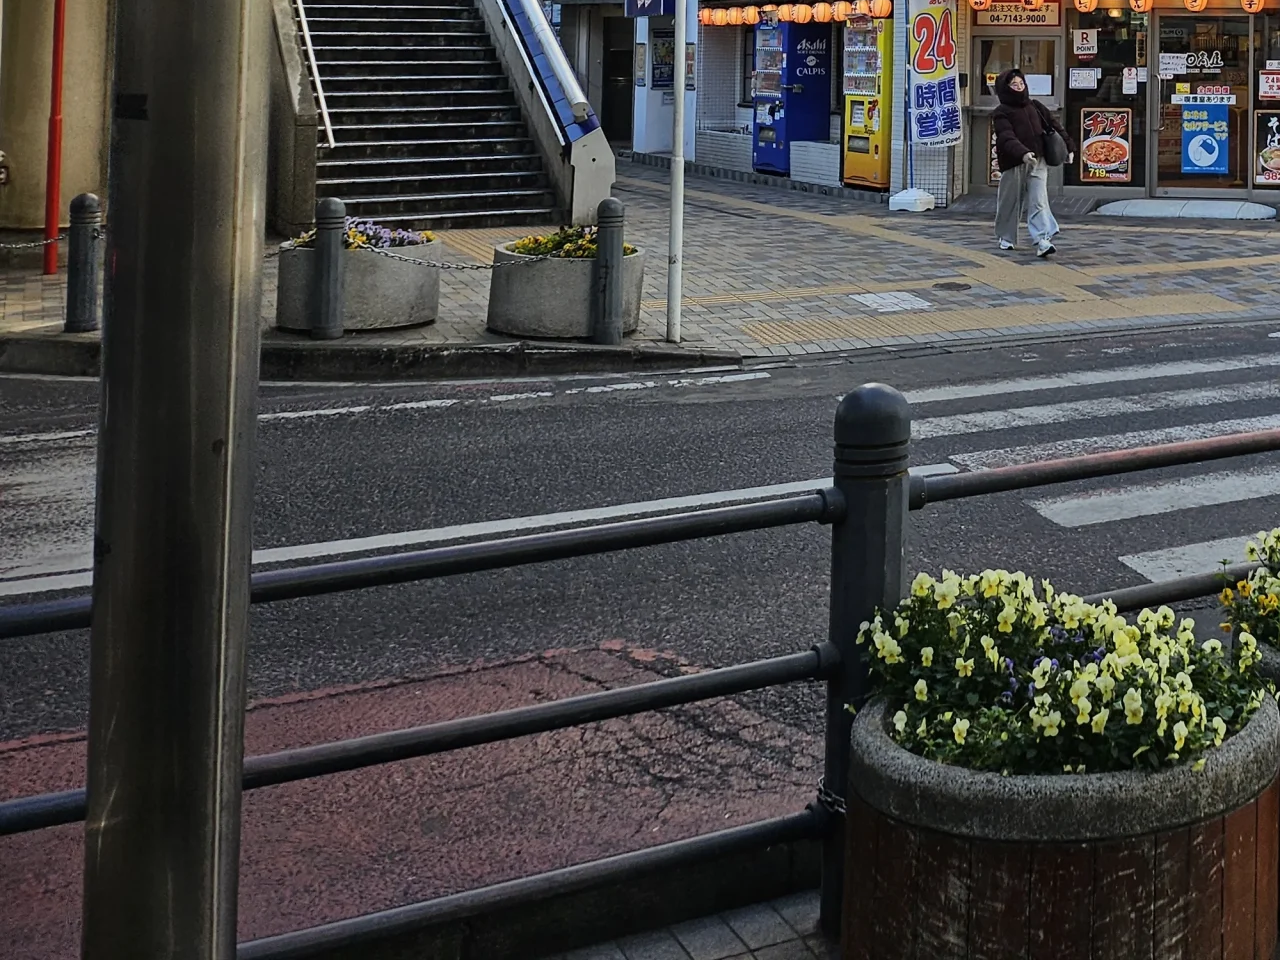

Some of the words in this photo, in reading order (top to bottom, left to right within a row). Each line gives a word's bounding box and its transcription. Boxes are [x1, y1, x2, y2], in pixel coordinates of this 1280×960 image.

[990, 14, 1046, 23] 04-7143-9000
[797, 39, 826, 50] Asahi
[913, 8, 957, 74] 24
[1081, 32, 1089, 43] R
[1186, 51, 1223, 67] 日高屋
[796, 68, 826, 76] CALPIS
[914, 77, 958, 109] 時間
[916, 106, 962, 139] 営業
[1083, 112, 1127, 140] チゲ
